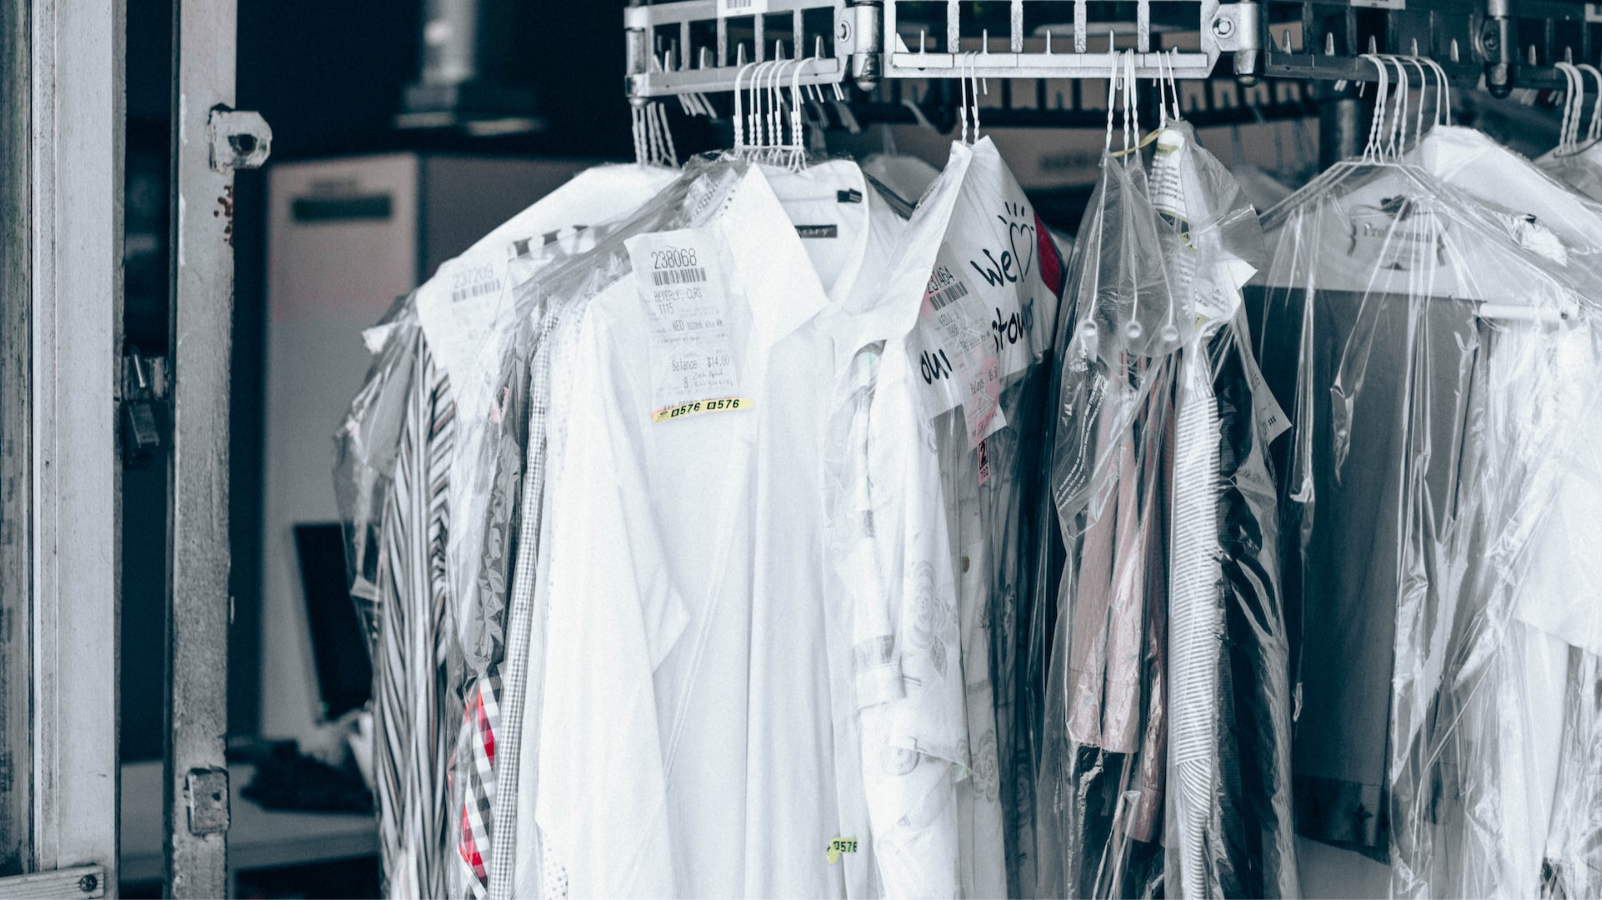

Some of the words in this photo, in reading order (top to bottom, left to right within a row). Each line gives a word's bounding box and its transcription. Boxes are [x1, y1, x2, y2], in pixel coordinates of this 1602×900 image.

[651, 248, 698, 269] 238068
[970, 248, 1017, 287] We
[672, 358, 698, 372] Balance
[707, 355, 730, 368] $14.00
[680, 402, 701, 415] 576
[718, 399, 740, 409] 576
